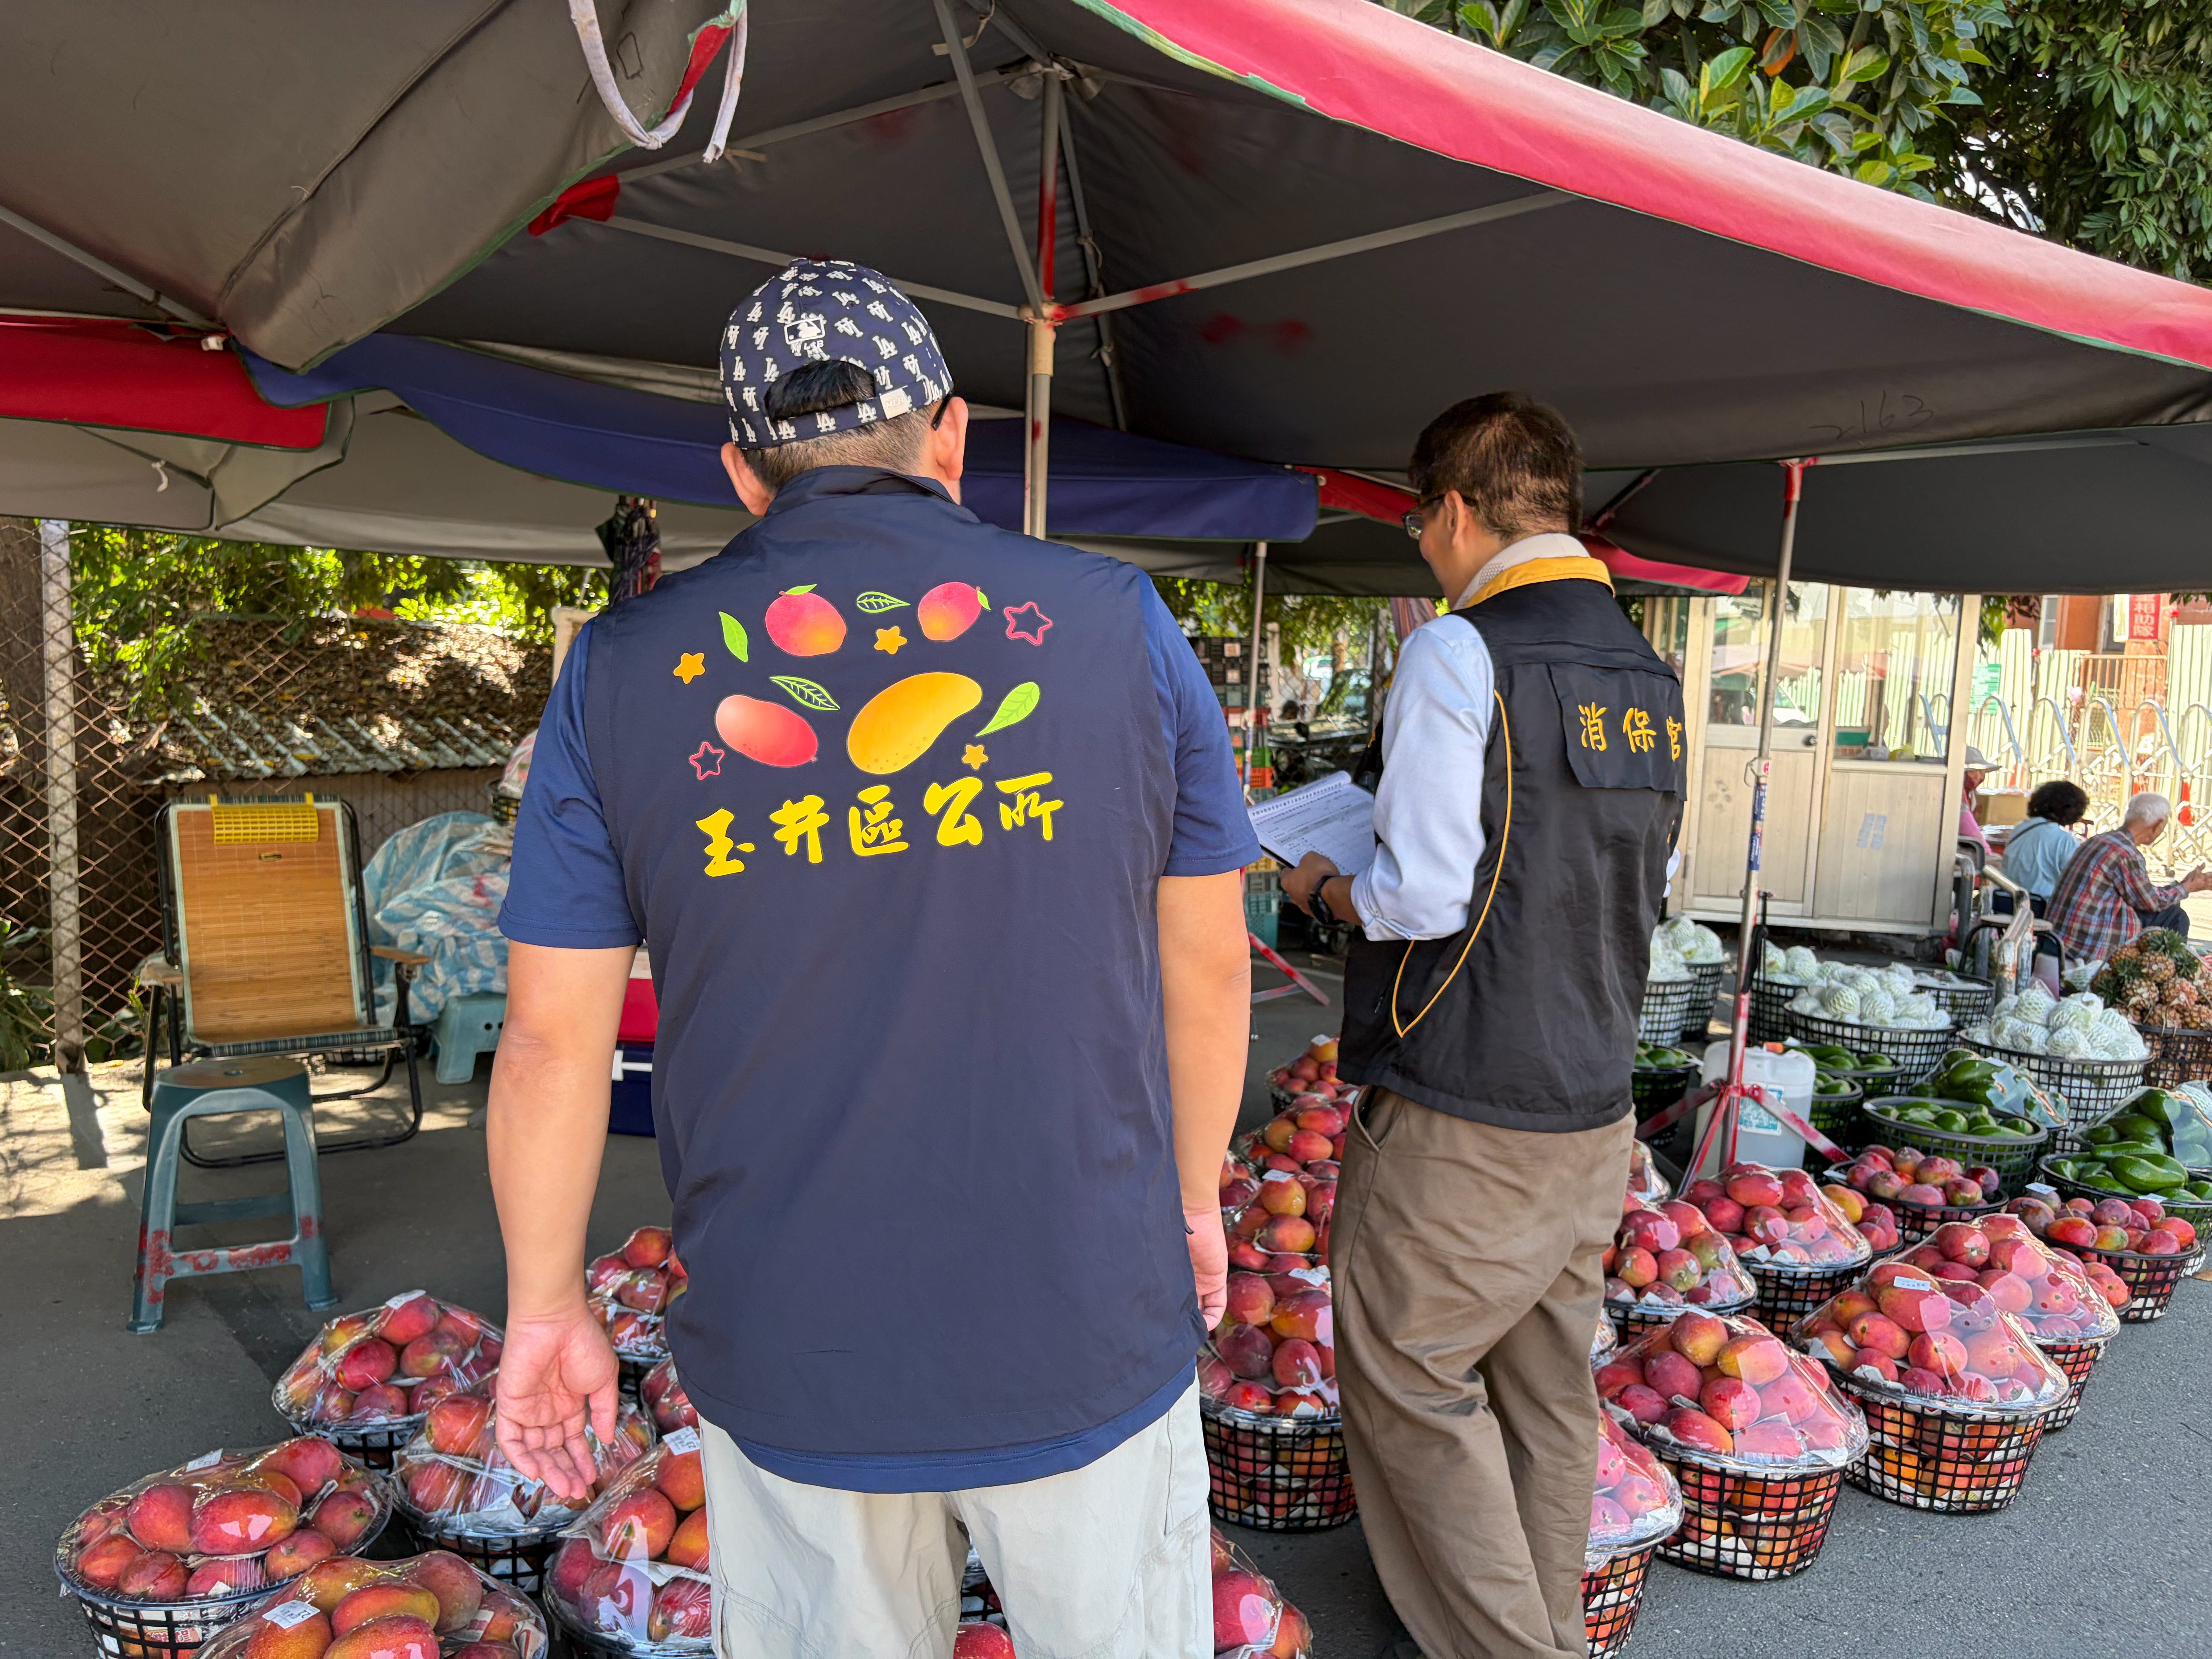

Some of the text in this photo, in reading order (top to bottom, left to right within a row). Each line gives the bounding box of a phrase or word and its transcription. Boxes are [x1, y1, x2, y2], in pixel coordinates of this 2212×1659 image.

[1578, 702, 1682, 761] 消保官
[696, 772, 1063, 877] 玉井區公所
